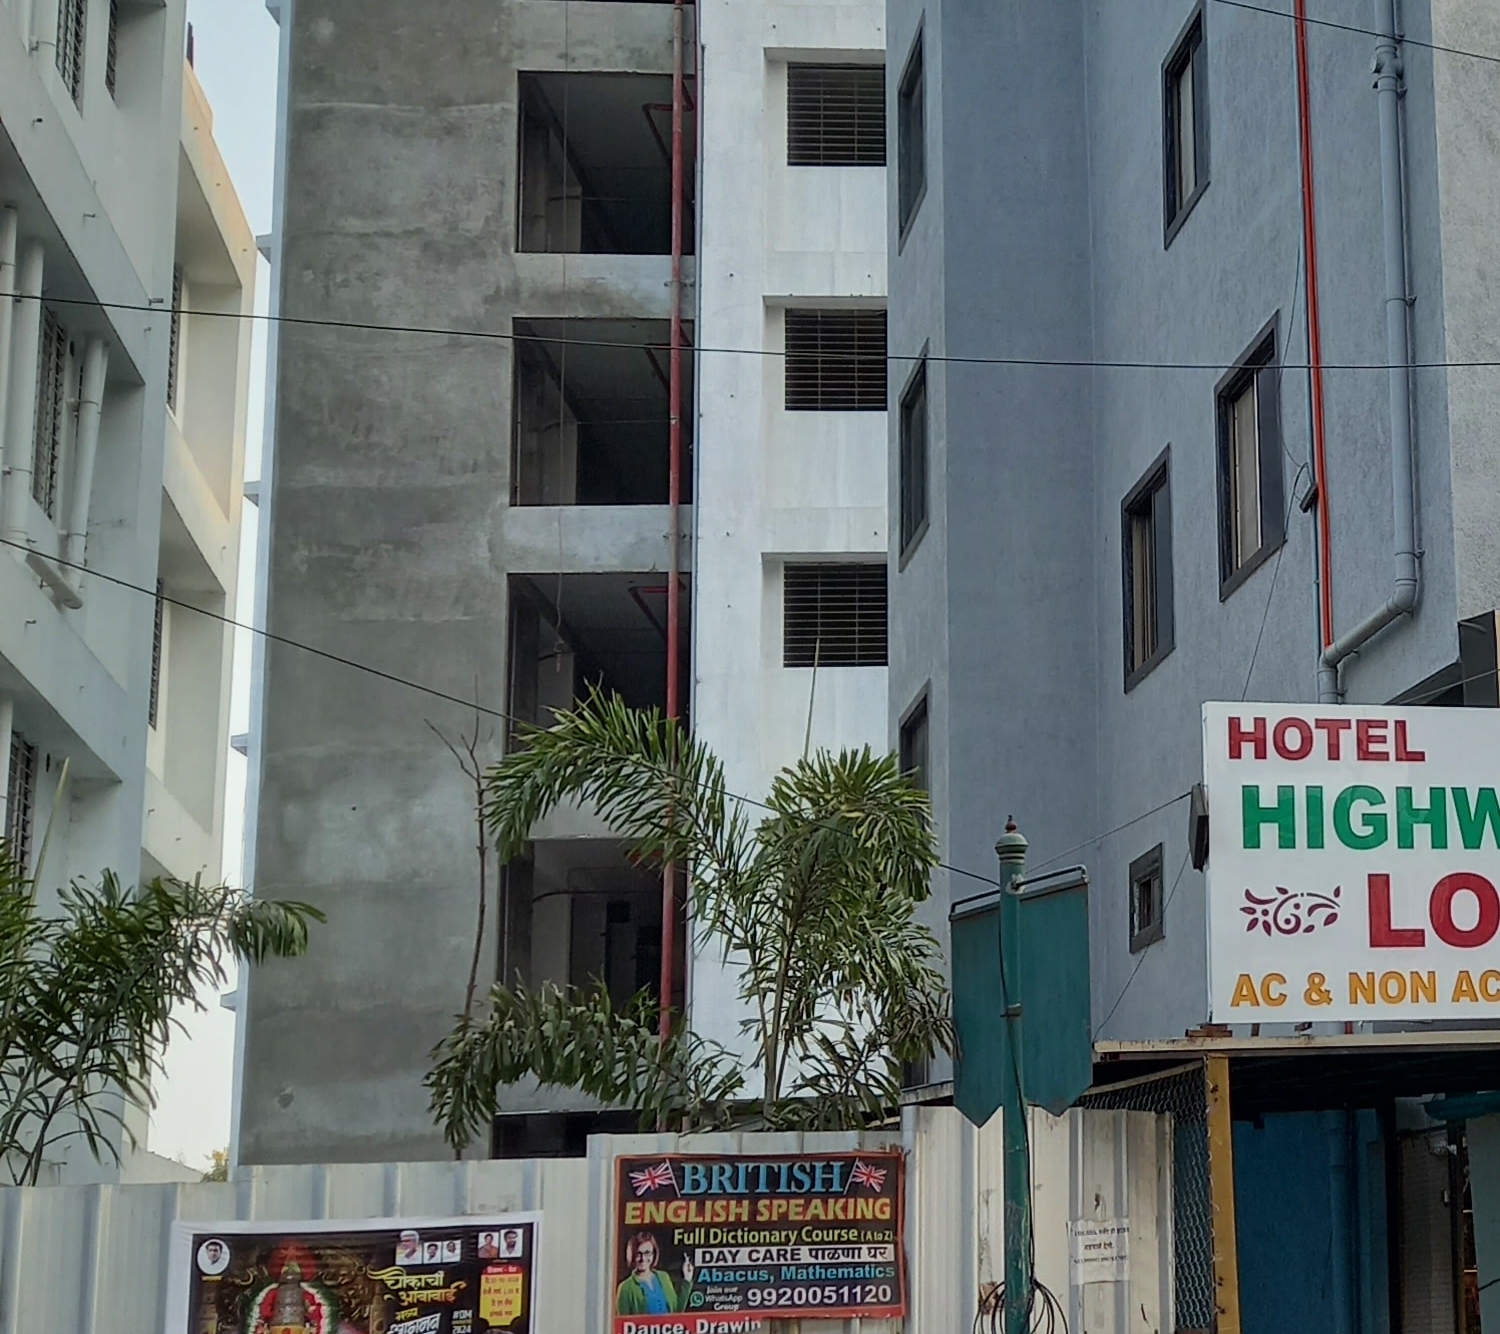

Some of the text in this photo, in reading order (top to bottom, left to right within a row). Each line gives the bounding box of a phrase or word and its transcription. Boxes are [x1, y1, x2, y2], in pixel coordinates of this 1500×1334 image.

[1228, 717, 1425, 762] HOTEL
[1230, 973, 1287, 1007] AC
[1303, 972, 1333, 1005] &
[1348, 970, 1436, 1004] NON
[679, 1160, 845, 1196] BRITISH
[624, 1197, 891, 1225] ENGLISH SPEAKING
[673, 1228, 704, 1246] Full
[709, 1226, 798, 1246] Dictionary
[801, 1225, 858, 1242] Course
[701, 1245, 889, 1264] DAY CARE पाळणा घर
[697, 1264, 895, 1284] Abacus, Mathematics
[704, 1294, 743, 1304] WhatsApp
[746, 1284, 892, 1307] 9920051120
[713, 1303, 739, 1312] Group
